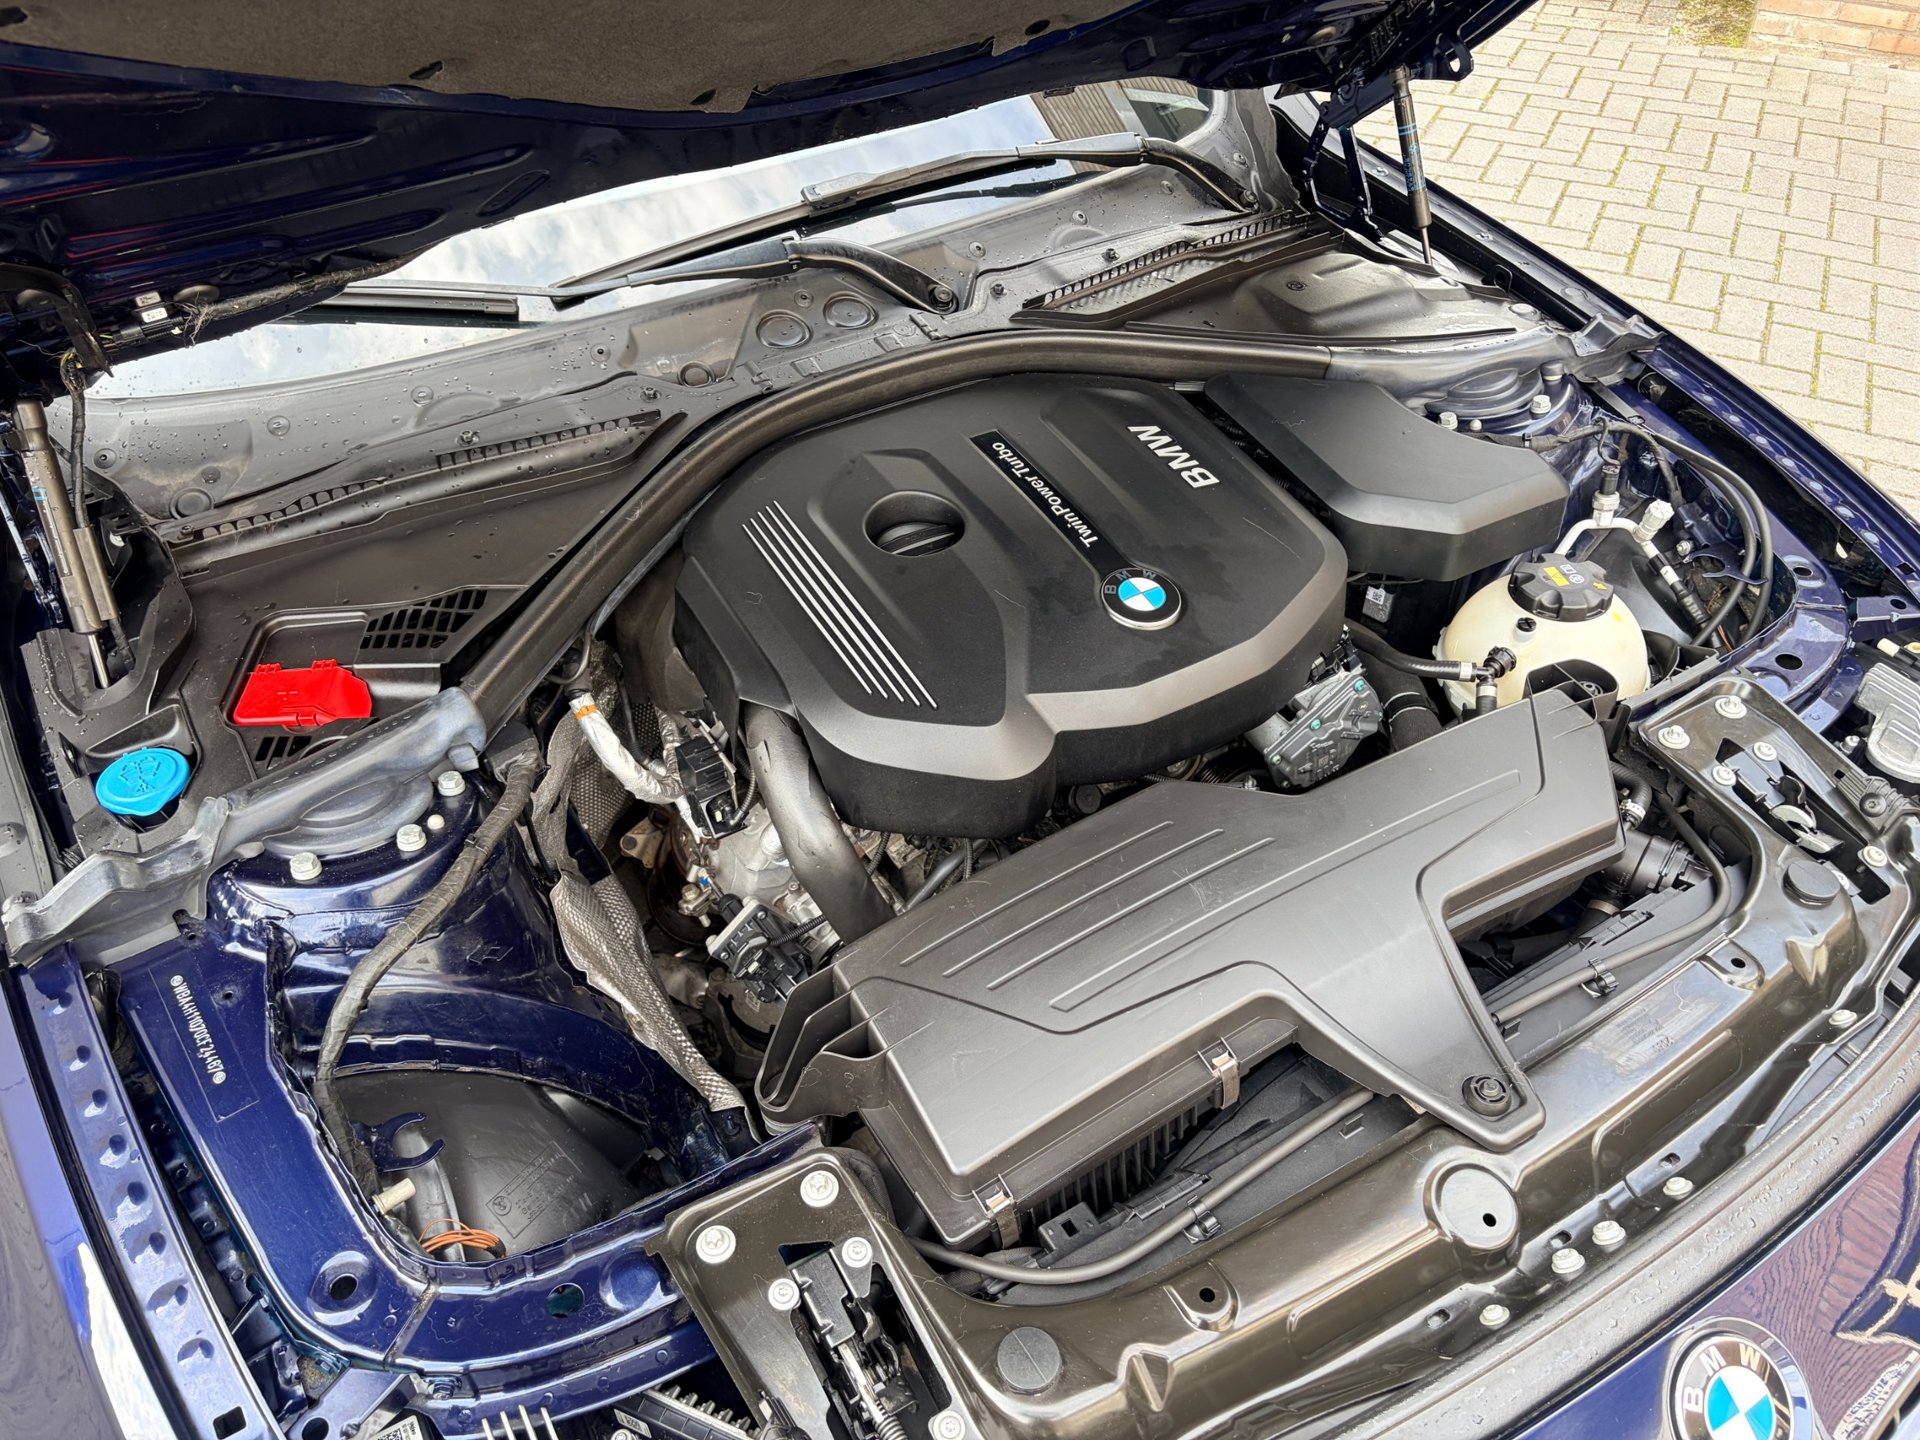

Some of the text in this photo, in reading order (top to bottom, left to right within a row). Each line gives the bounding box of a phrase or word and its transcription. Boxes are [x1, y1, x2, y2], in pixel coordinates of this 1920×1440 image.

[1127, 425, 1220, 489] BMW
[992, 442, 1099, 548] TwinPower Turbo
[1104, 570, 1156, 595] BMW
[1684, 1344, 1761, 1413] BMW
